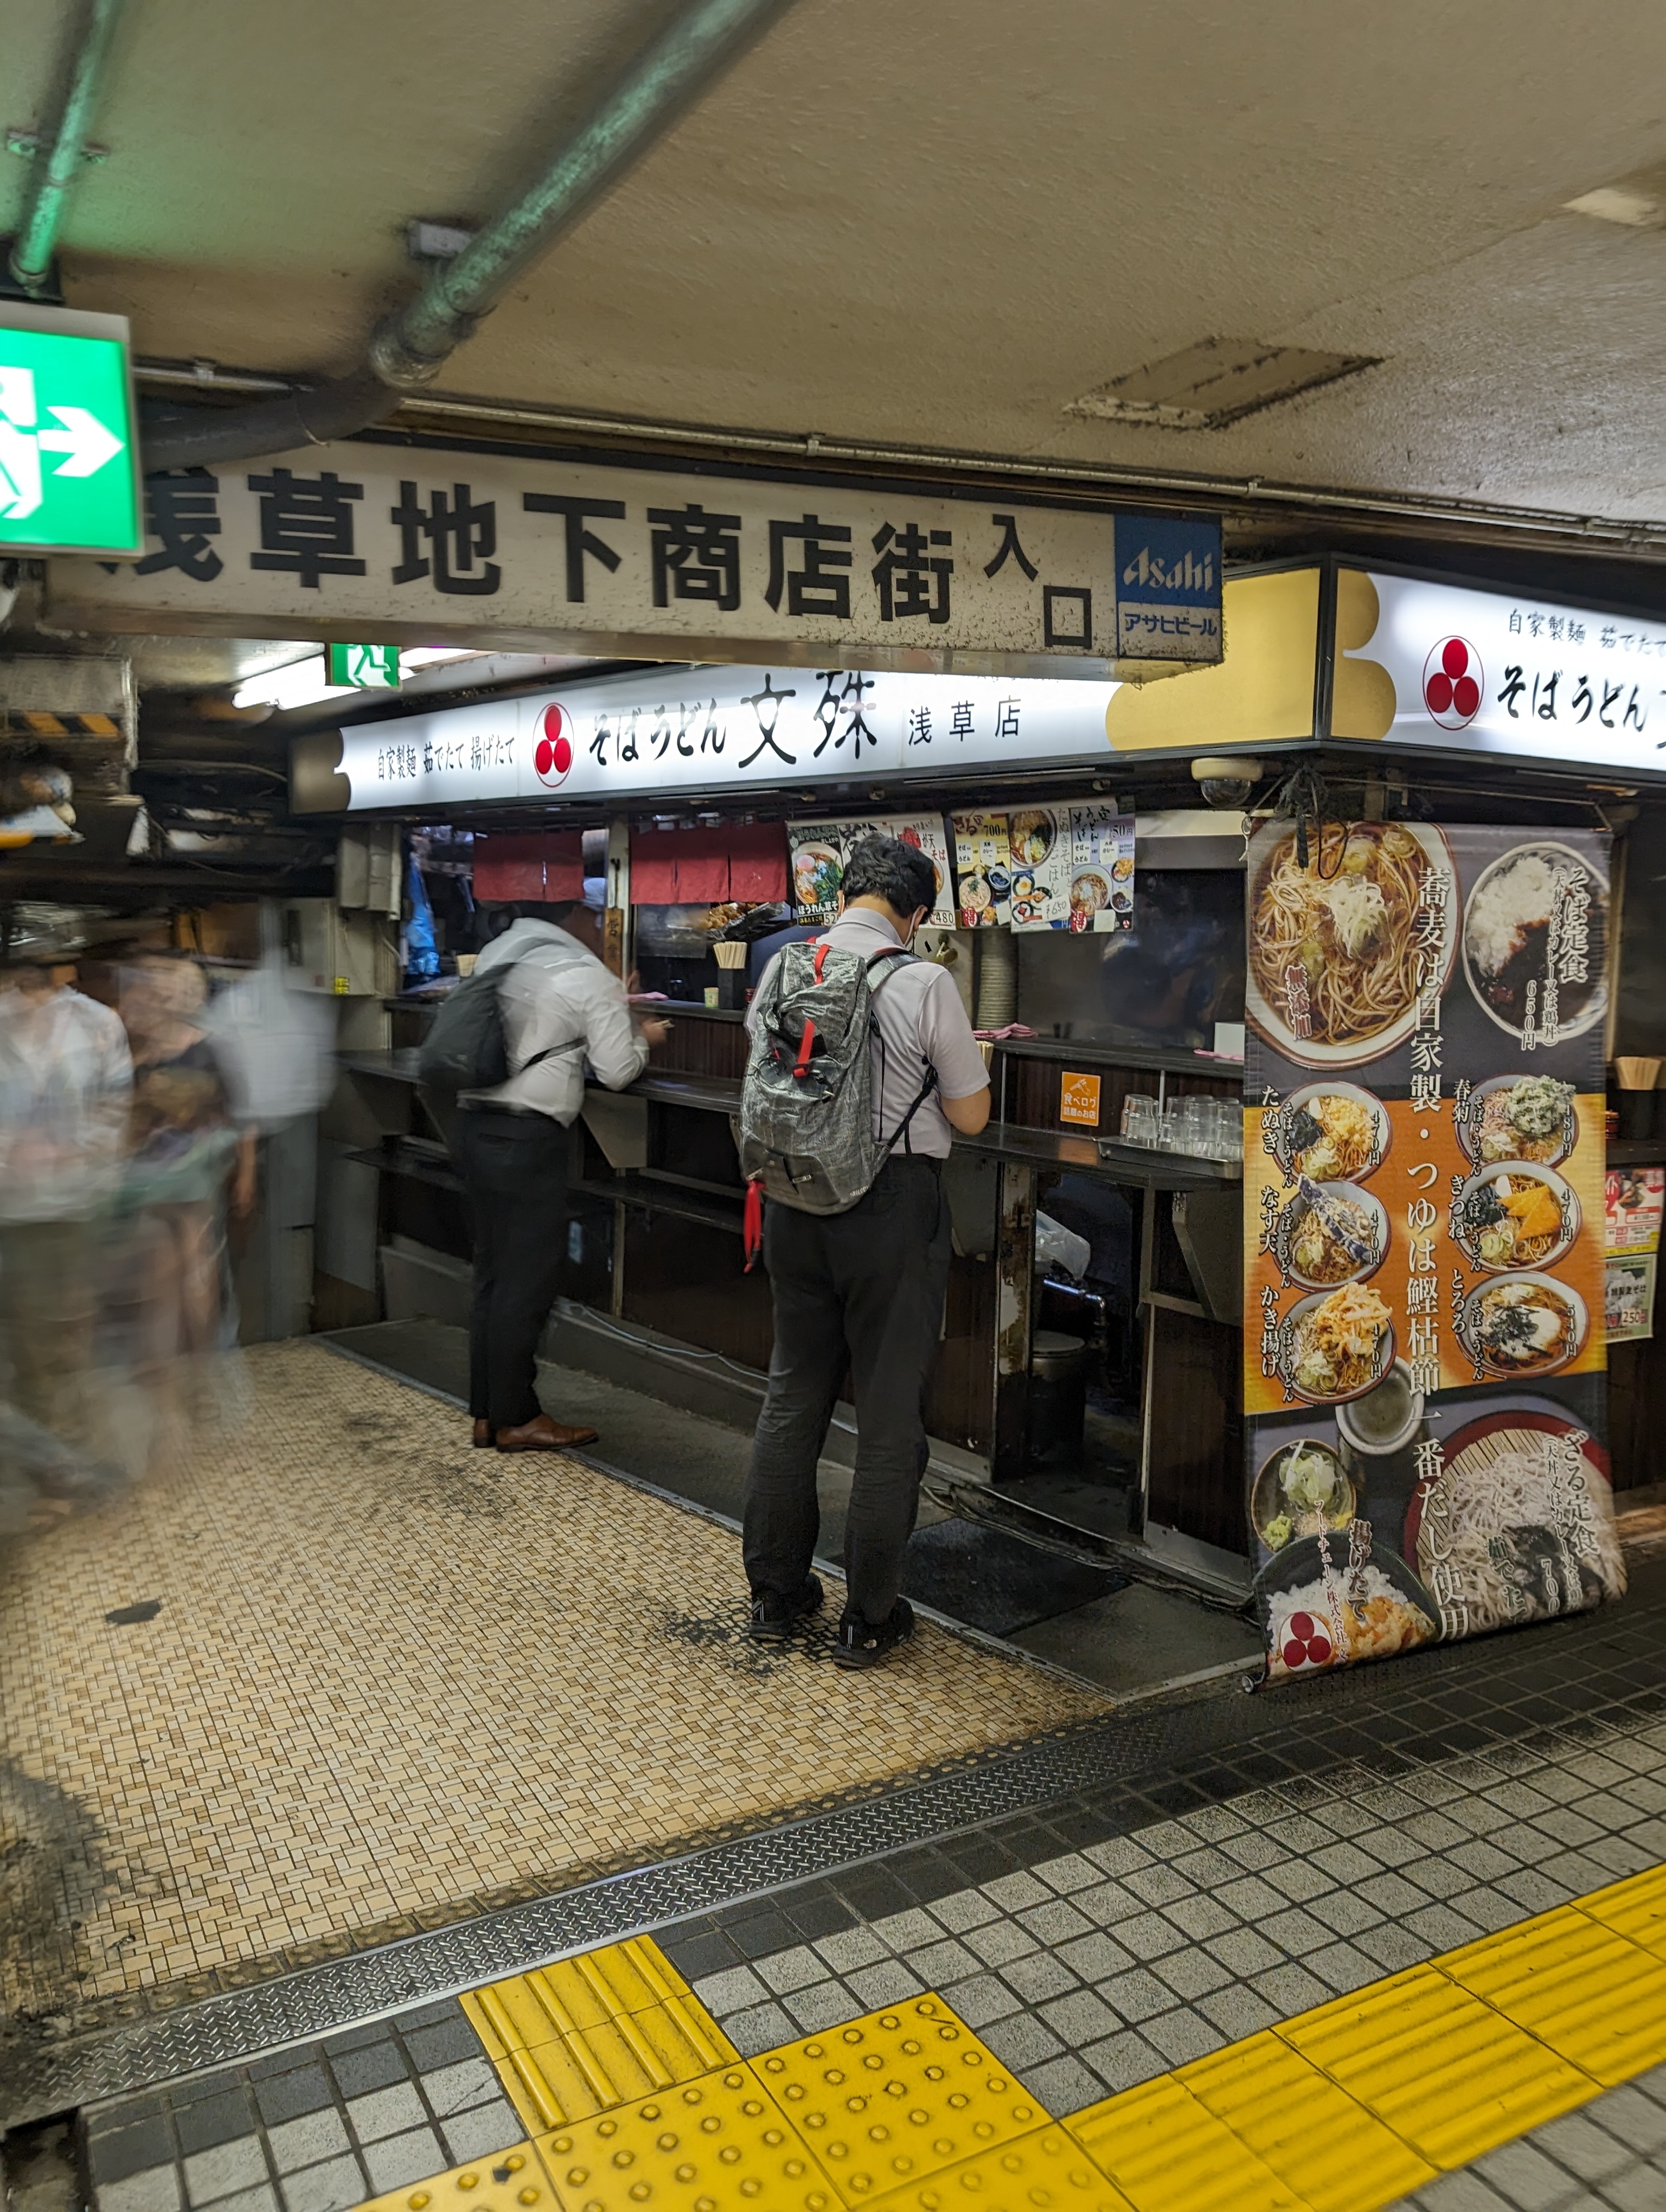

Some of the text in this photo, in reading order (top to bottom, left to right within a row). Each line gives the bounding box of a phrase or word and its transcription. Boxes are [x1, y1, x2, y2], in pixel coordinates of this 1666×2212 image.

[983, 513, 1092, 650] 入口
[1123, 546, 1214, 593] Asahi
[1124, 613, 1218, 636] アサヒビール
[1509, 607, 1587, 646] 自家製麺
[589, 670, 1022, 769] そばうどん 文殊 浅草店
[1497, 664, 1649, 733] そばうどん
[379, 734, 515, 781] 自家製麺 茹でたて 揚げたて
[1110, 824, 1133, 839] 50円
[825, 913, 840, 924] 52
[936, 911, 954, 924] 480
[1559, 866, 1591, 985] そば定食
[1521, 979, 1538, 1052] 650円
[1063, 1091, 1097, 1108] 食べログ
[1261, 1084, 1281, 1155] たぬき
[1452, 1078, 1471, 1124] 春菊
[1368, 1110, 1381, 1166] 470円
[1259, 1185, 1280, 1256] なす天
[1447, 1174, 1467, 1241] きつね
[1560, 1188, 1573, 1243] 470円
[1369, 1209, 1381, 1266] 470円
[1450, 1269, 1466, 1335] とろろ
[1260, 1284, 1281, 1378] かき揚げ
[1370, 1323, 1383, 1380] 470円
[1565, 1304, 1578, 1358] 540円
[1563, 1427, 1601, 1559] ざる定食
